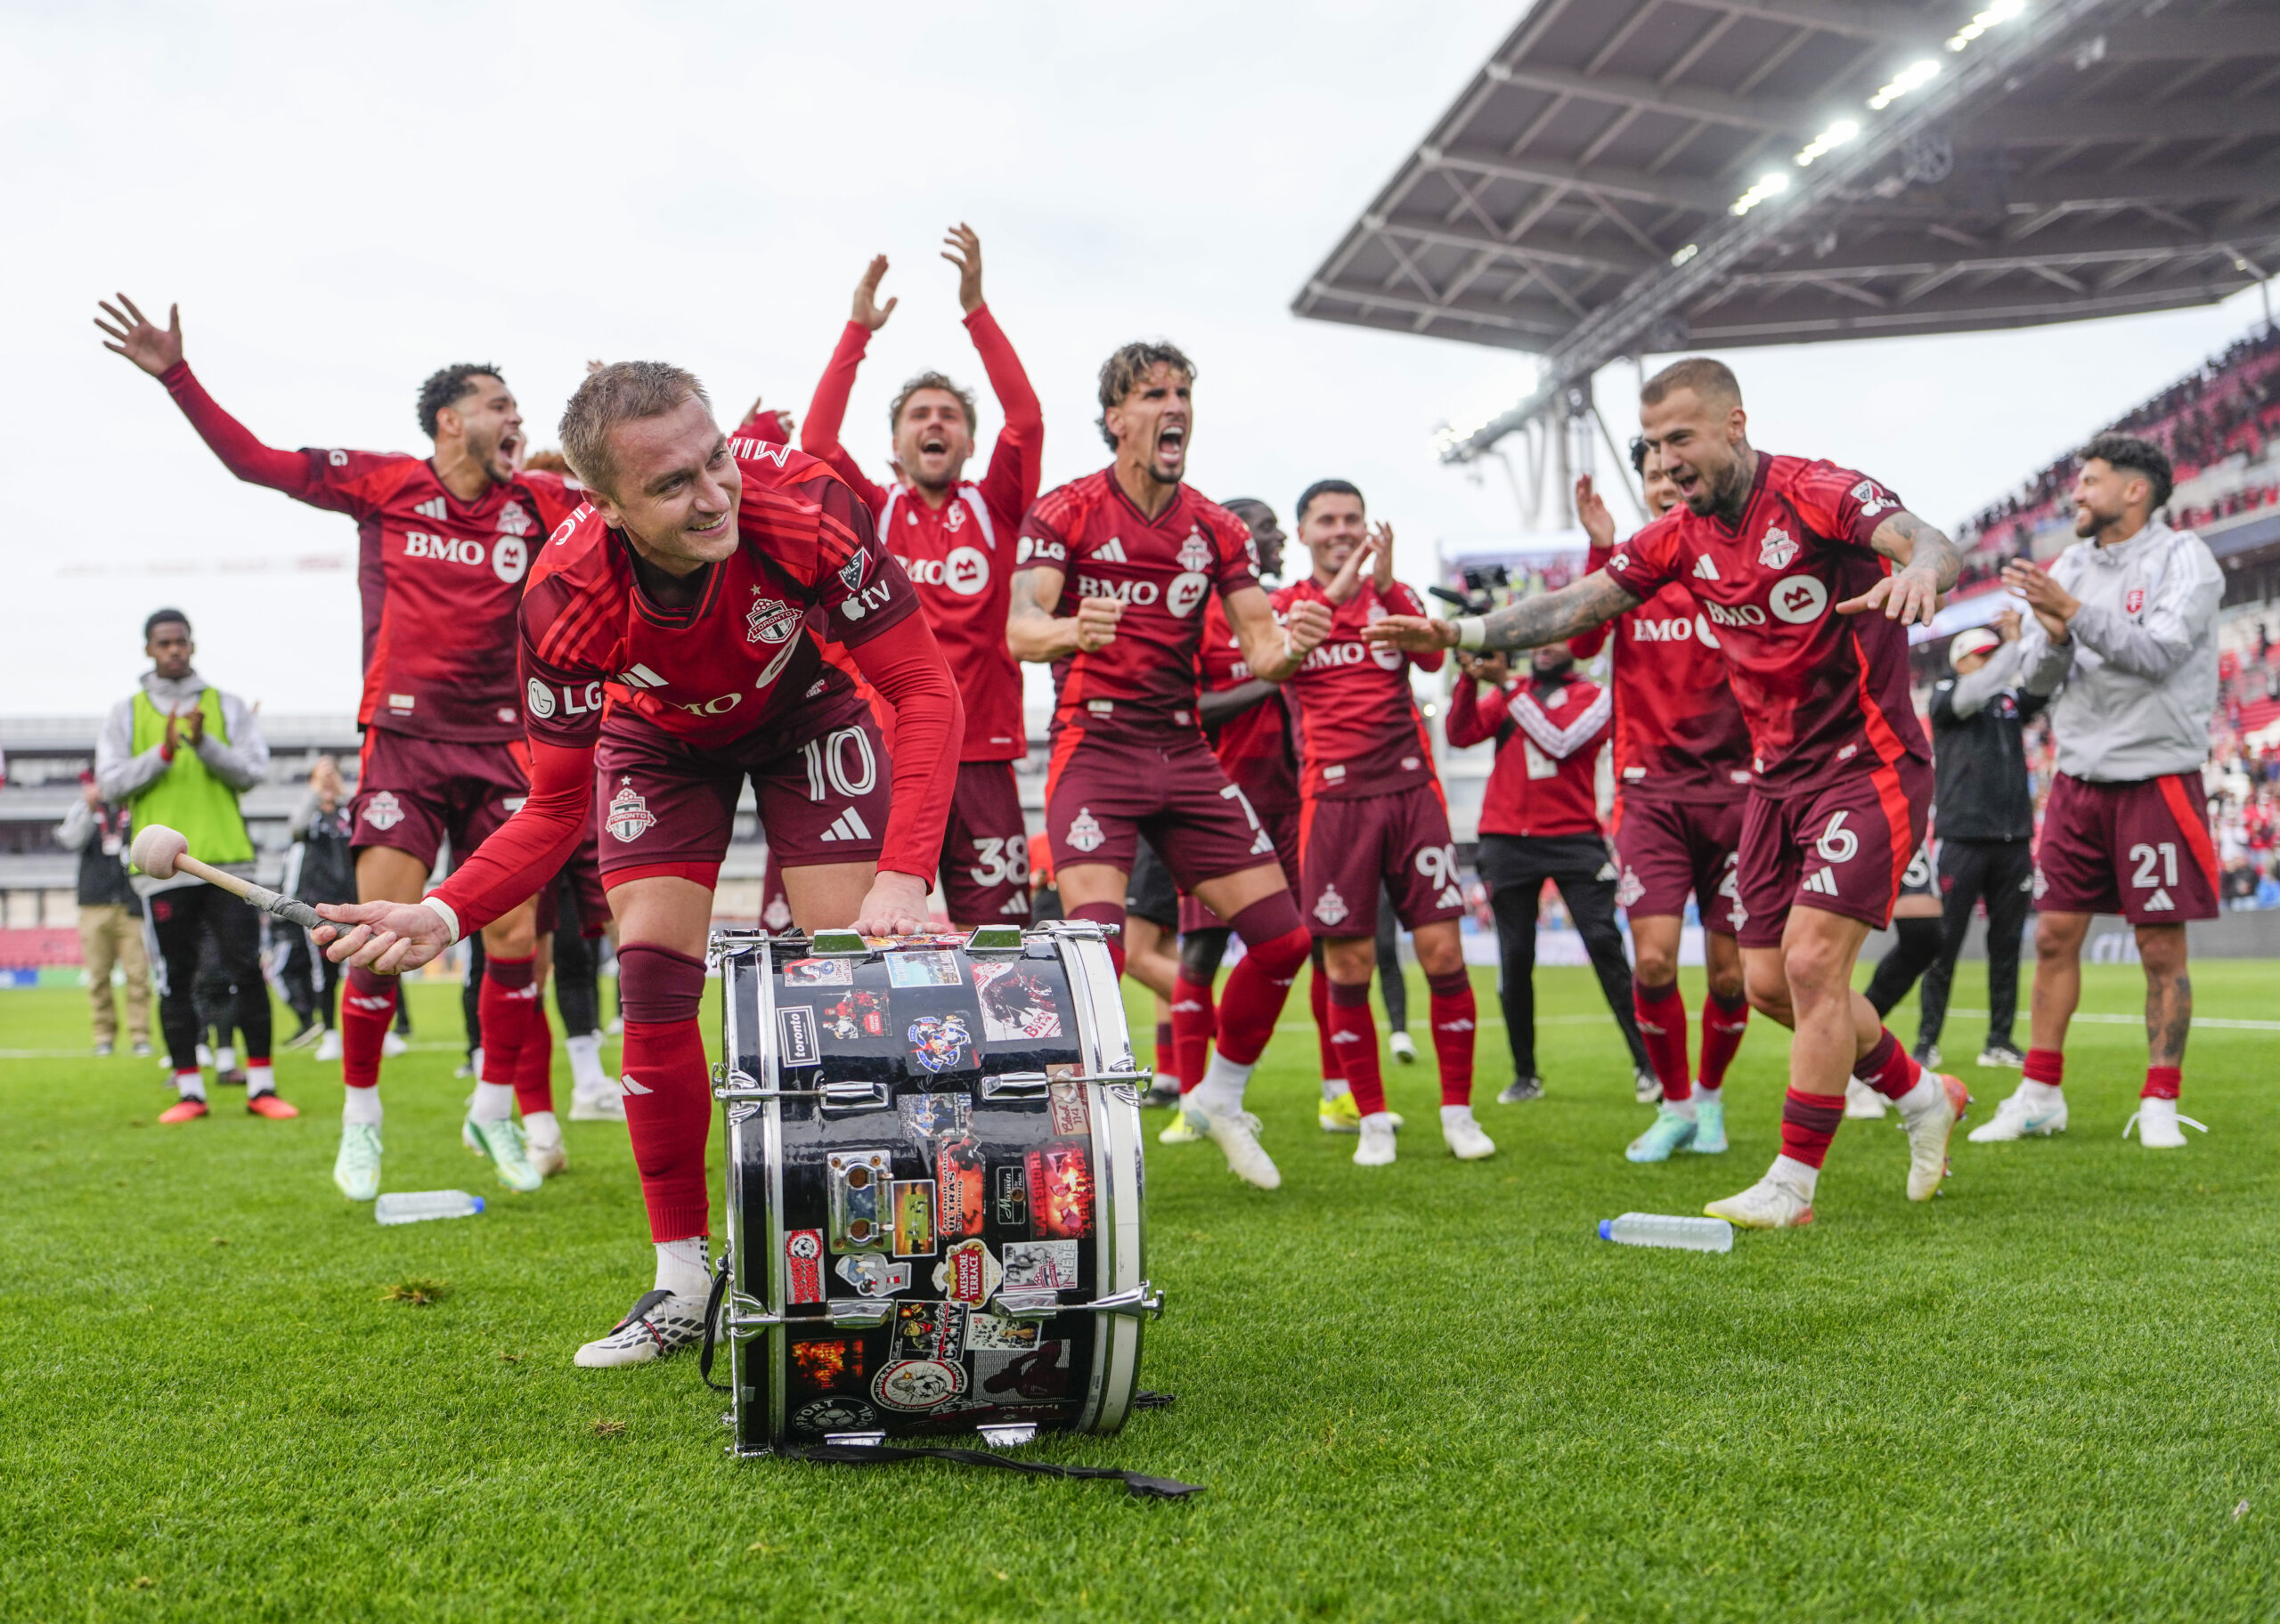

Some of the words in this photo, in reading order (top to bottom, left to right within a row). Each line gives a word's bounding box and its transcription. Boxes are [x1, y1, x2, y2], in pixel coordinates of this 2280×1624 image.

[403, 532, 485, 565] BMO
[1034, 538, 1066, 561] LG
[843, 558, 860, 577] MLS
[861, 579, 892, 610] tv
[1078, 574, 1159, 605] BMO
[753, 610, 793, 634] TORONTO
[1633, 618, 1692, 642] BMO
[1704, 600, 1766, 627] BMO
[563, 680, 603, 715] LG
[797, 725, 876, 802] 10
[610, 813, 647, 824] TORONTO
[1816, 810, 1859, 864] 6
[971, 834, 1030, 889] 38
[1414, 842, 1461, 890] 90
[1719, 851, 1739, 897] 2
[2129, 841, 2178, 889] 21
[791, 1012, 806, 1058] toronto
[1060, 1105, 1073, 1132] Block
[1071, 1108, 1082, 1124] 114
[949, 1171, 957, 1231] ULTRAS
[998, 1173, 1012, 1219] Maxwin
[959, 1253, 969, 1299] LAKESHORE
[969, 1255, 979, 1296] TERRACE
[1062, 1242, 1076, 1276] REDS
[790, 1255, 807, 1303] LAKESHORE
[941, 1303, 964, 1360] CXIV
[875, 1363, 898, 1393] ULTRAS
[795, 1399, 834, 1432] SUPPORT
[848, 1405, 874, 1431] LOCAL
